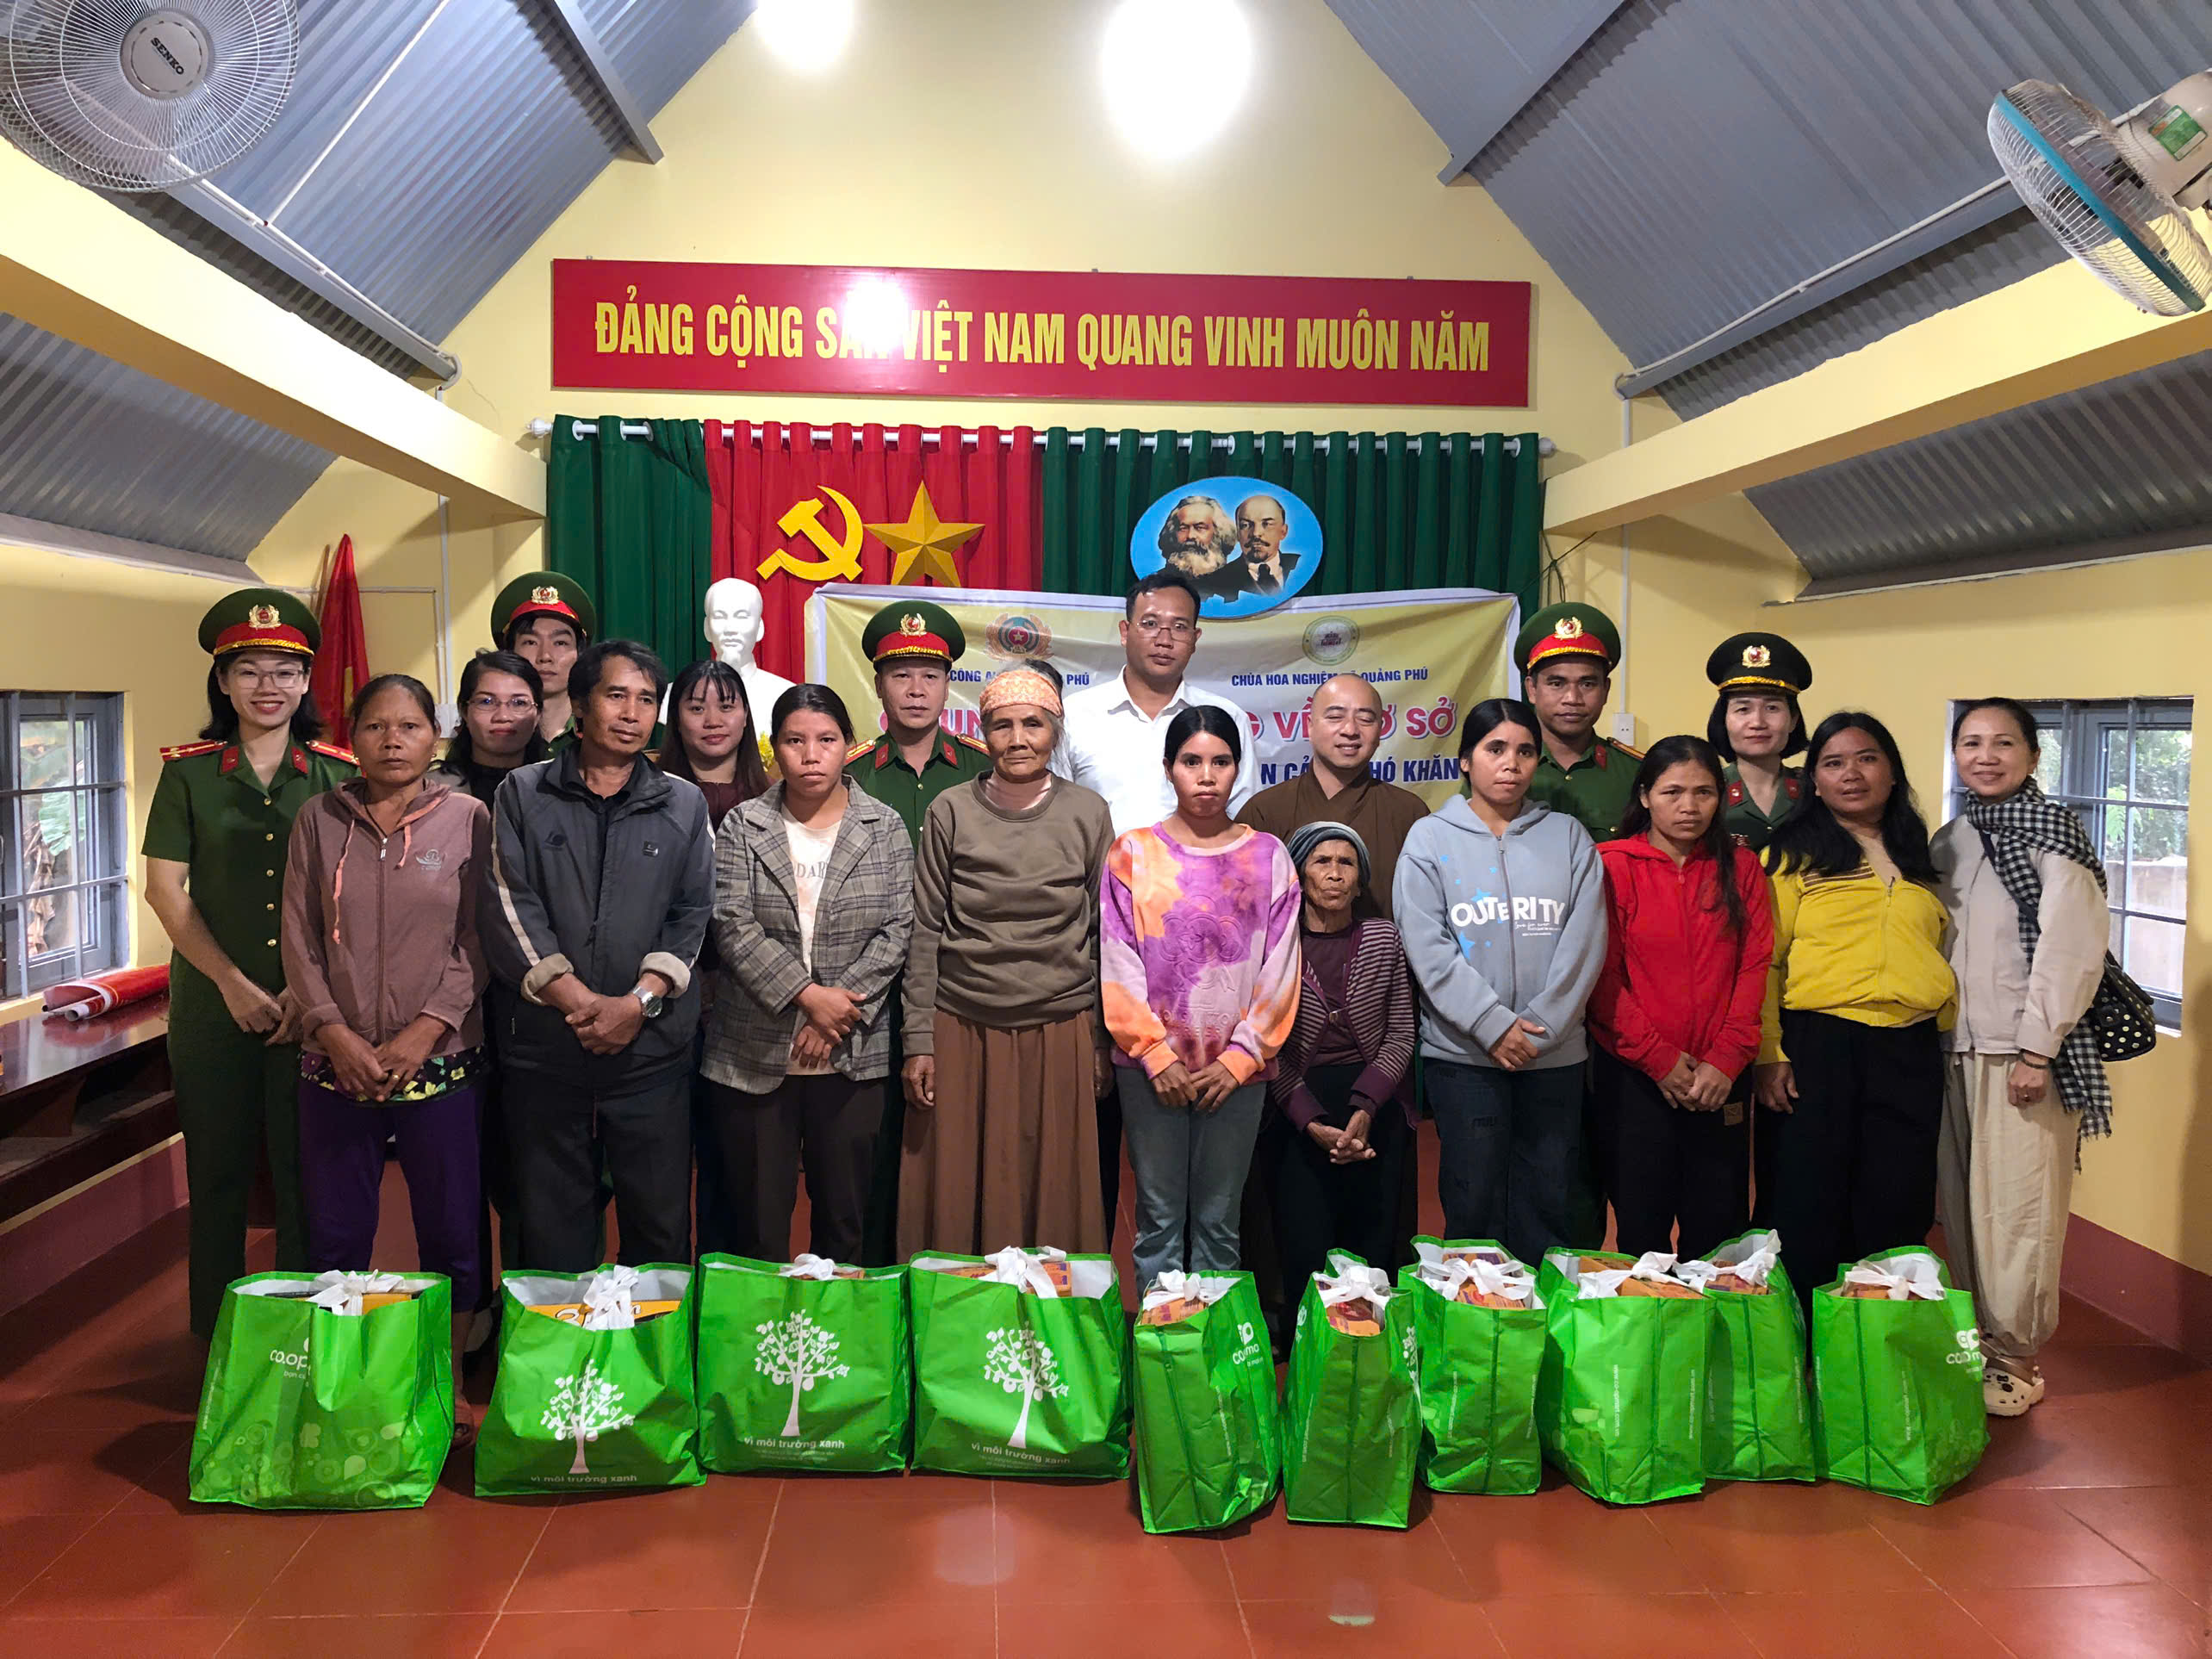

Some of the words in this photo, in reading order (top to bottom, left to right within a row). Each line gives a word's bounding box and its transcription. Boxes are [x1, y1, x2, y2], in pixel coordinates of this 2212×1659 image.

[151, 37, 184, 75] SENKO
[595, 285, 693, 356] ĐẢNG
[706, 294, 803, 368] CỘNG
[902, 299, 973, 373] VIỆT
[984, 311, 1065, 364] NAM
[1077, 313, 1192, 371] QUANG
[1204, 316, 1284, 368] VINH
[1296, 308, 1399, 370] MUÔN
[1410, 310, 1489, 372] NĂM
[950, 668, 982, 682] CÔNG
[1066, 672, 1090, 686] PHÚ
[1231, 672, 1264, 687] CHÙA
[1266, 674, 1289, 686] HOA
[1292, 670, 1338, 686] NGHIÊ
[1405, 666, 1429, 680] PHÚ
[1406, 696, 1455, 737] SỞ
[1369, 755, 1396, 782] HÓ
[1403, 754, 1459, 782] KHĂN
[1451, 896, 1566, 927] OUTERITY
[819, 1439, 845, 1449] xanh
[983, 1445, 1003, 1455] môi
[610, 1474, 637, 1482] xanh
